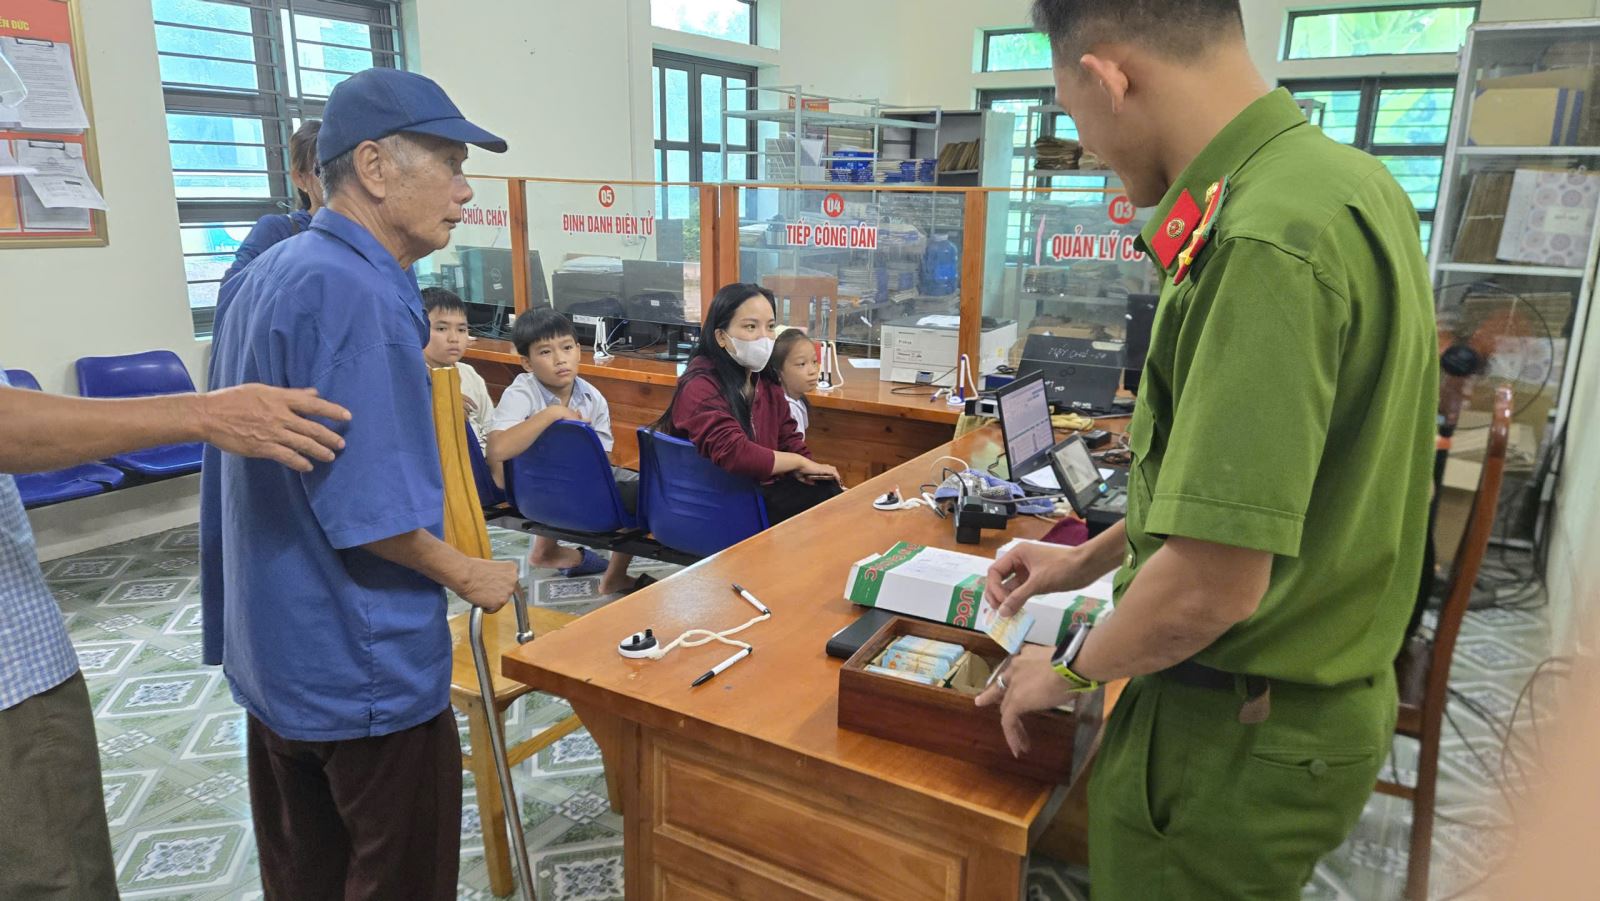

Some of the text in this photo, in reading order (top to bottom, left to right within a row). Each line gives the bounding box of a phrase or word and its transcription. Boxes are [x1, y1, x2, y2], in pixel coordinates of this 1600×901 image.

[601, 189, 613, 204] 05
[826, 197, 841, 213] 04
[1114, 201, 1133, 219] 03
[563, 209, 654, 238] ĐỊNH DANH ĐIỆN TỬ
[786, 217, 877, 248] TIẾP CÔNG DÂN
[1052, 224, 1095, 260] QUẢN
[1098, 230, 1119, 259] LÝ
